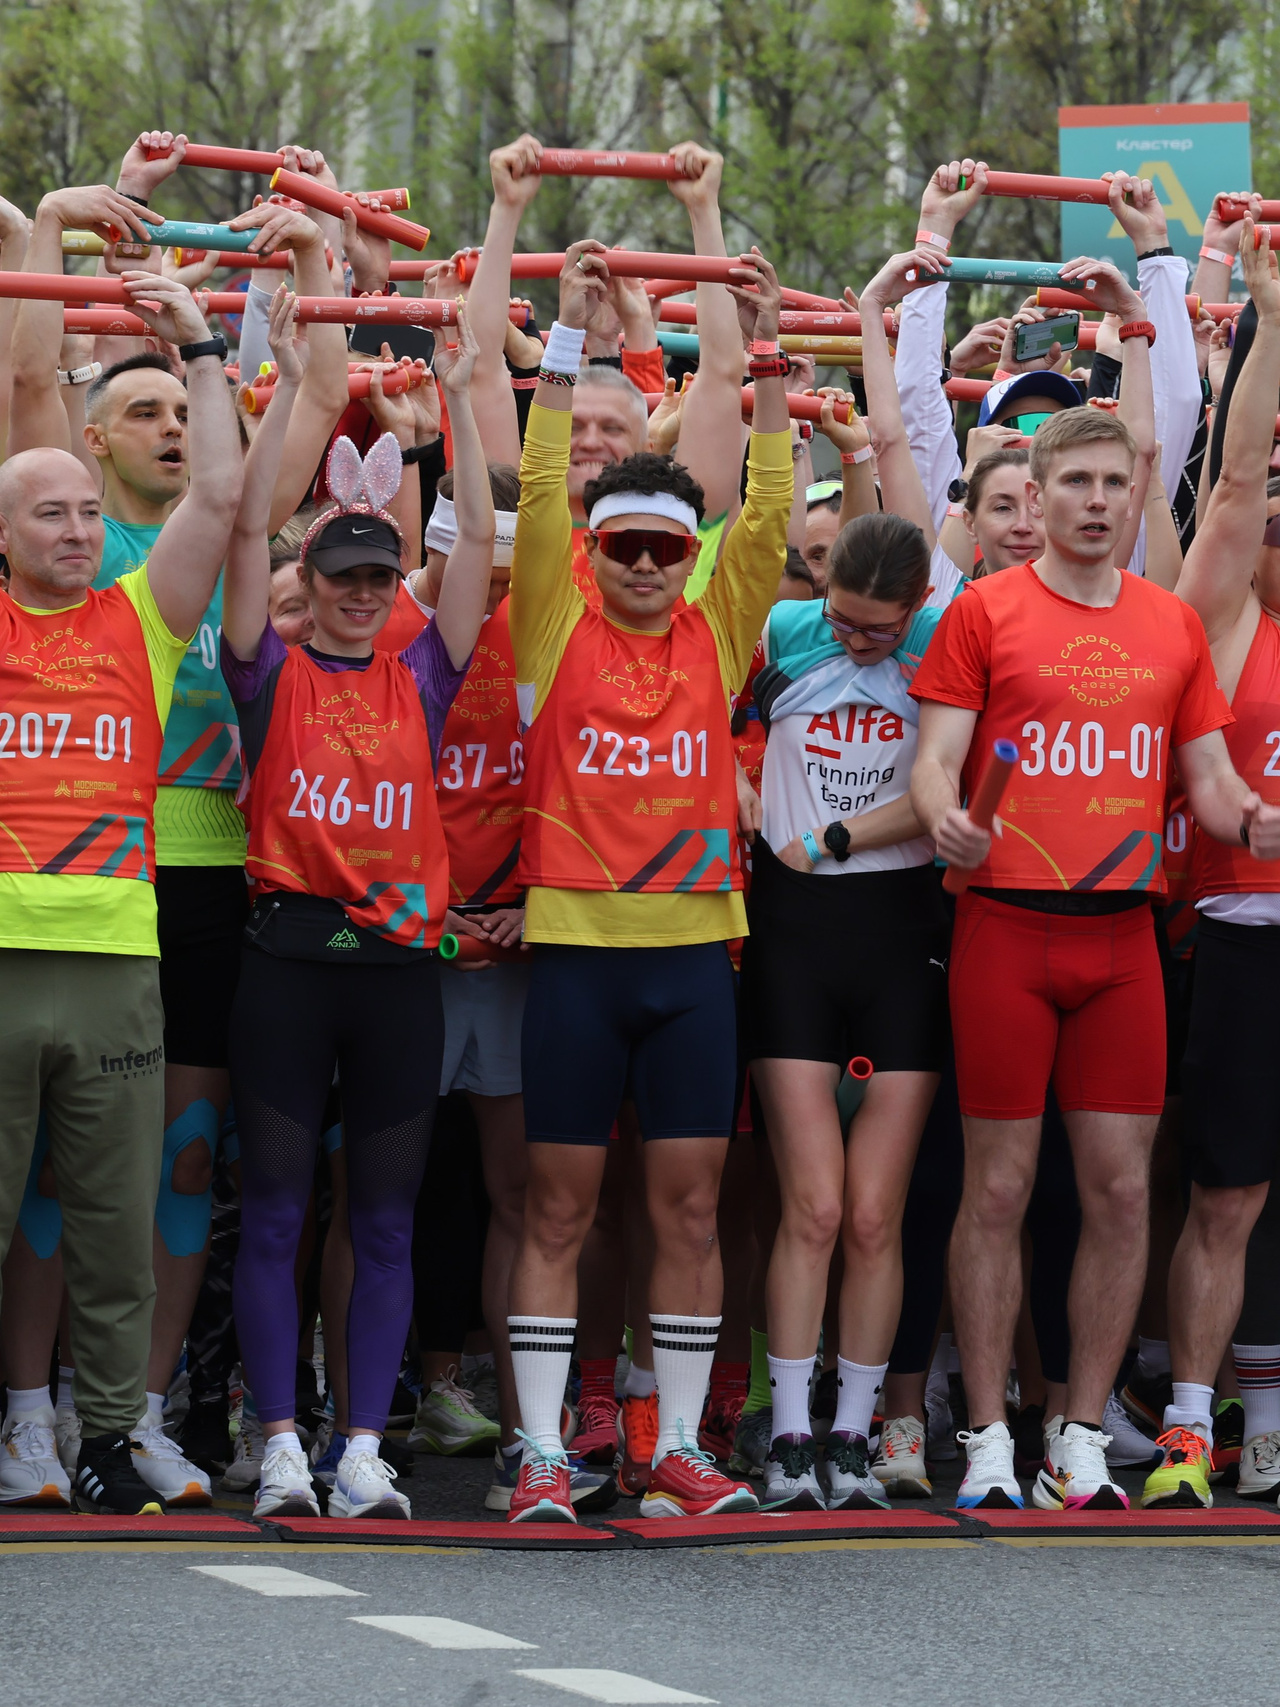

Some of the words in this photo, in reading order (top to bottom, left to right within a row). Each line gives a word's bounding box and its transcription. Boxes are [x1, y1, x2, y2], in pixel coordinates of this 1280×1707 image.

[1115, 137, 1194, 152] Кластер
[441, 302, 450, 323] 266
[1059, 634, 1131, 662] САДОВОЕ
[5, 653, 118, 671] ЭСТАФЕТА
[1037, 664, 1156, 681] ЭСТАФЕТА
[1080, 681, 1117, 690] 2025
[1067, 684, 1132, 708] КОЛЬЦО
[806, 704, 904, 744] Alfa
[0, 711, 132, 763] 207-01
[577, 726, 707, 778] 223-01
[1020, 720, 1165, 781] 360-01
[806, 761, 896, 787] running
[73, 779, 118, 791] МОСКОВСКИЙ
[73, 789, 97, 800] СПОРТ
[287, 768, 413, 831] 266-01
[652, 796, 695, 808] МОСКОВСКИЙ
[820, 784, 875, 813] team
[1104, 796, 1146, 808] МОСКОВСКИЙ
[652, 806, 674, 816] СПОРТ
[1104, 806, 1126, 816] СПОРТ
[348, 846, 393, 859] МОСКОВСКИЙ
[346, 856, 369, 868] СПОРТ
[100, 1045, 163, 1074] Inferno
